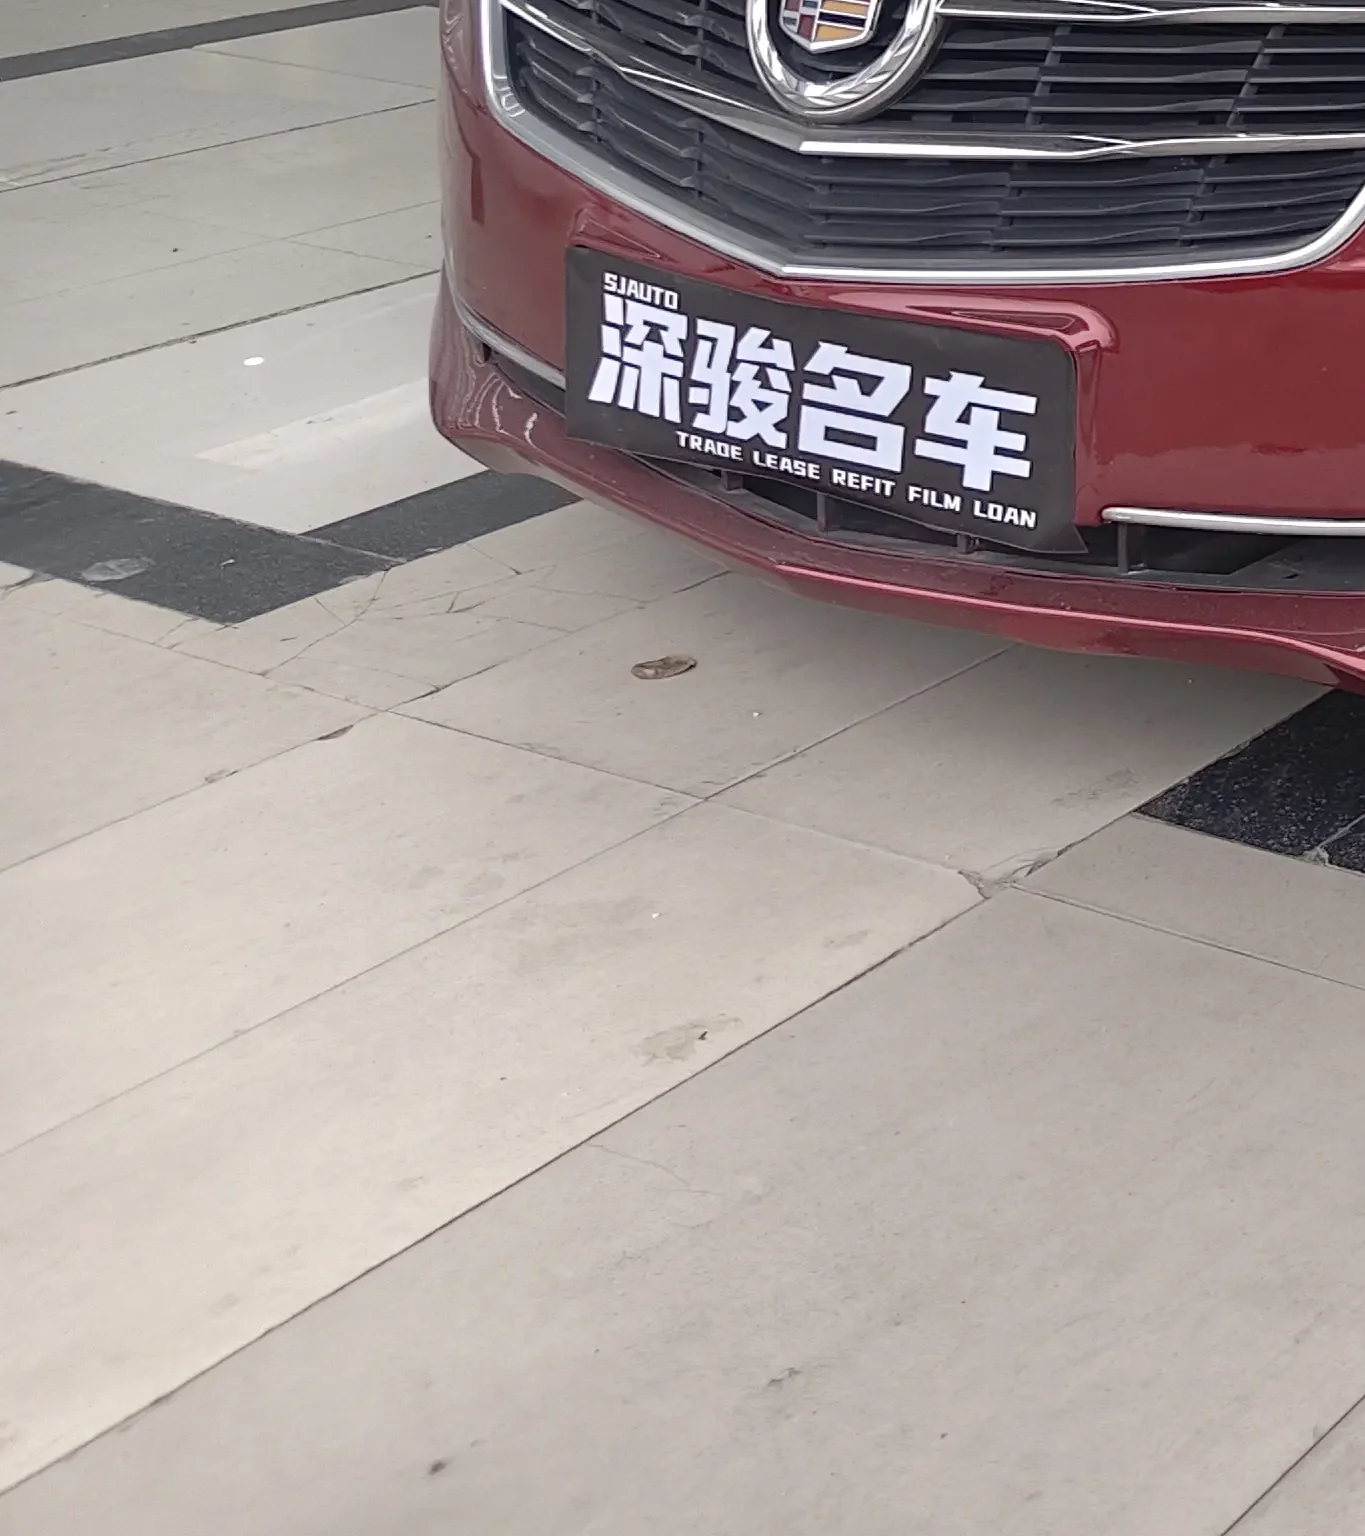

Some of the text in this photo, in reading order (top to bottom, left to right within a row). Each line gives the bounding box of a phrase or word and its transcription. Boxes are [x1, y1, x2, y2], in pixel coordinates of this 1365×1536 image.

[602, 272, 679, 311] SJAUTO
[587, 293, 1038, 493] 深骏名车
[676, 430, 1038, 529] TRADE LEASE REFIT FILM LOAN
